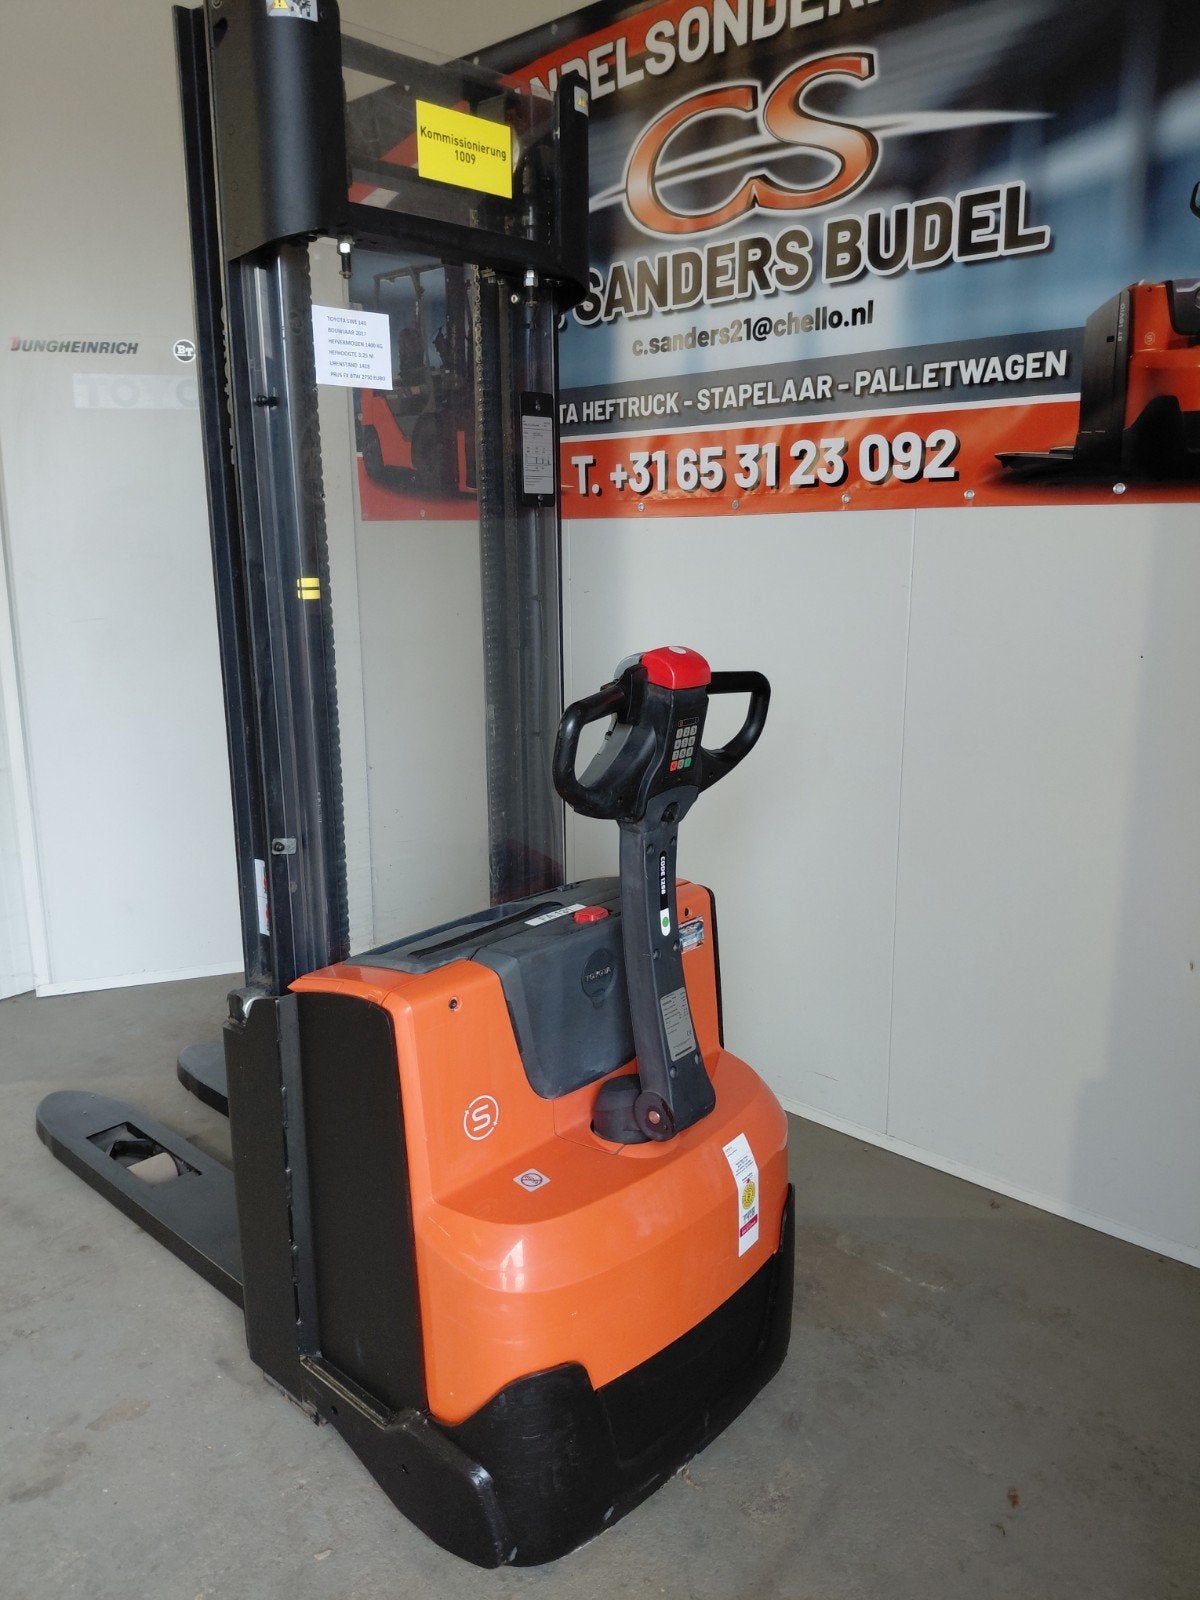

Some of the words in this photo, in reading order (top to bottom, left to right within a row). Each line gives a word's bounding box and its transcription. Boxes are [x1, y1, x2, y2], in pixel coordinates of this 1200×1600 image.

[420, 125, 507, 161] Kommissionierung
[454, 149, 476, 165] 1009
[573, 226, 813, 326] SANDERS
[822, 180, 1052, 284] BUDEL
[10, 335, 139, 355] JUNGHEINRICH
[632, 299, 874, 357] c.sanders21@chello.nl
[582, 392, 679, 422] HEFTRUCK
[697, 374, 832, 411] STAPELAAR
[854, 349, 1068, 395] PALLETWAGEN
[571, 455, 601, 495] T.
[610, 450, 666, 493] +31
[676, 446, 725, 491] 65
[734, 442, 778, 489] 31
[789, 437, 847, 486] 23
[859, 429, 957, 482] 092
